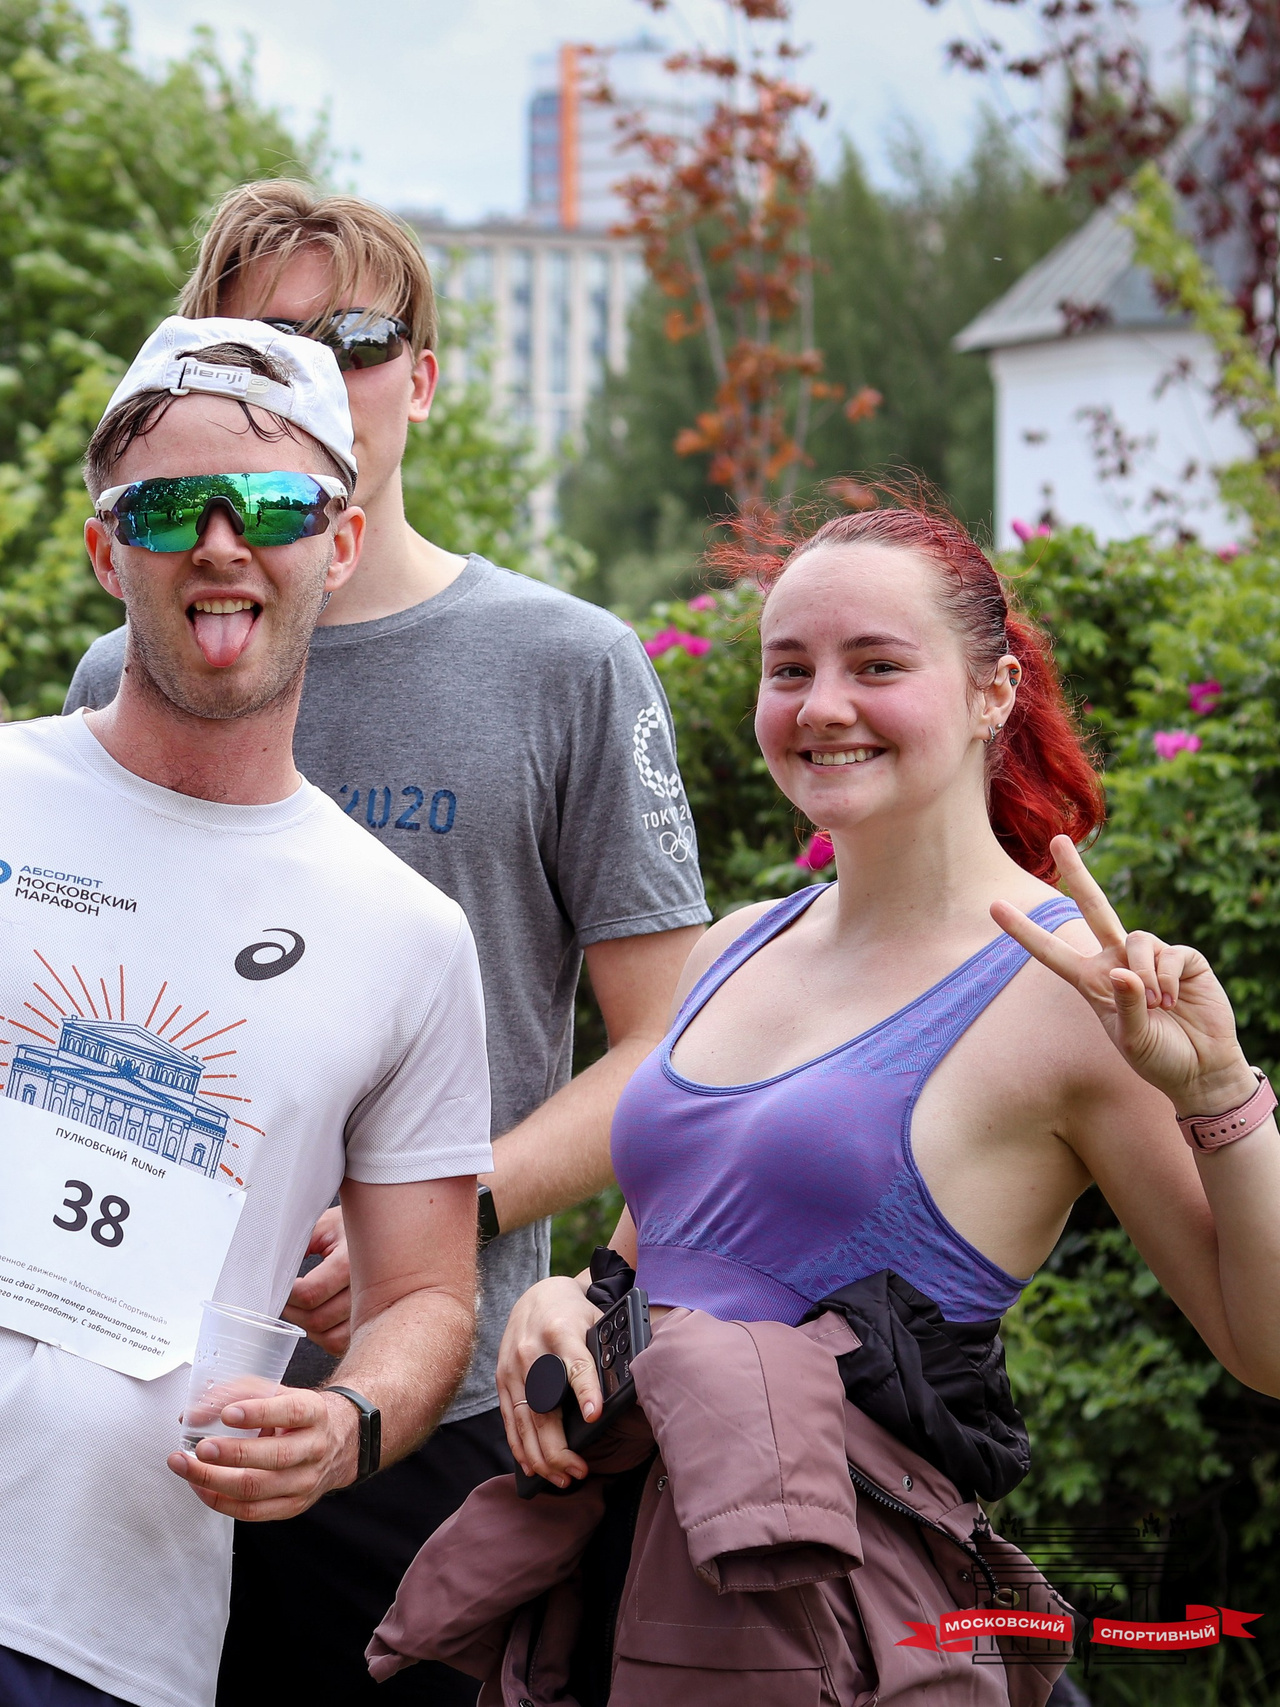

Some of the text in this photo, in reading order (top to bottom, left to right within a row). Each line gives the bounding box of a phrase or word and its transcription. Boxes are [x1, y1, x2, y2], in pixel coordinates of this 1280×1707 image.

[15, 887, 100, 917] МАРАФОН
[17, 875, 138, 913] МОСКОВСКИЙ
[20, 865, 103, 889] АБСОЛЮТ
[55, 1127, 167, 1179] ПУЛКОВСКИЙ RUNoff
[52, 1179, 131, 1248] 38
[15, 1279, 36, 1291] сдай
[36, 1287, 60, 1301] этот
[60, 1297, 86, 1312] номер
[86, 1307, 149, 1338] организаторам,
[157, 1338, 171, 1346] мы
[26, 1264, 68, 1284] движение
[69, 1280, 118, 1304] «Московский
[118, 1300, 168, 1326] Спортивный»
[13, 1293, 24, 1302] на
[24, 1297, 79, 1324] переработку.
[81, 1318, 88, 1326] С
[87, 1324, 121, 1340] заботой
[128, 1339, 165, 1357] природе!
